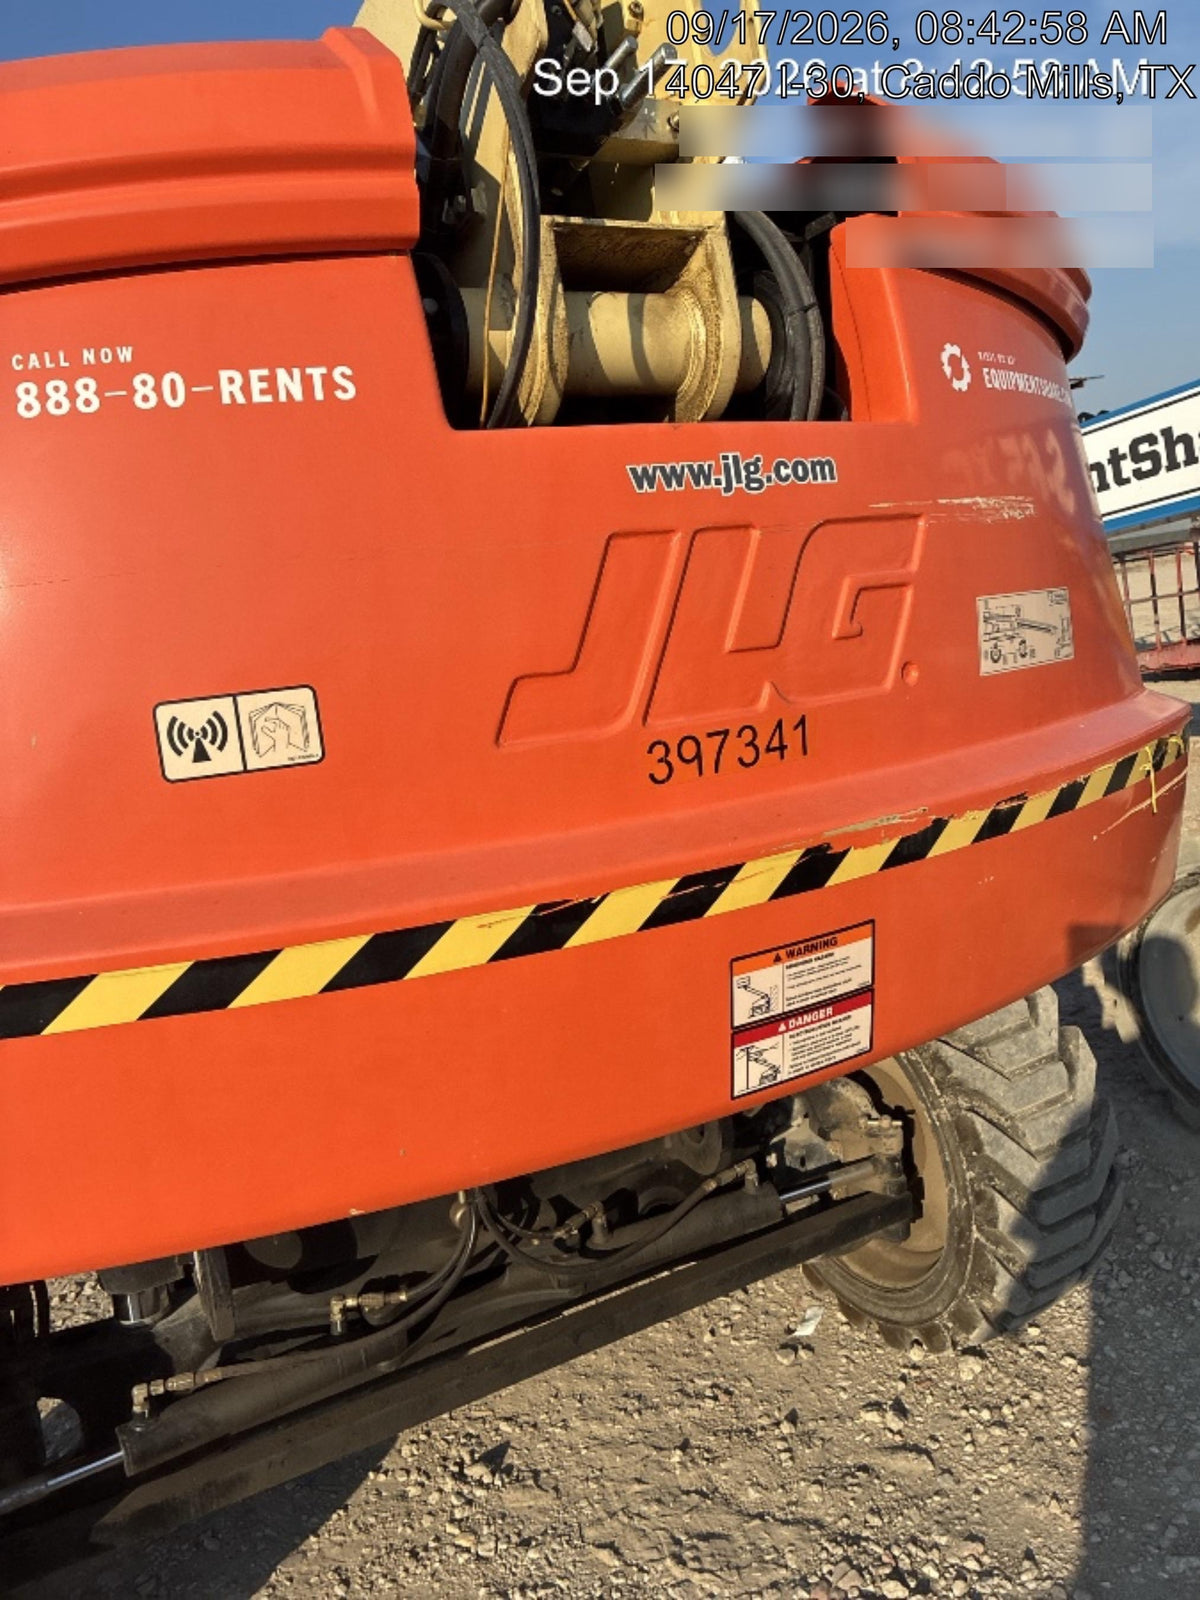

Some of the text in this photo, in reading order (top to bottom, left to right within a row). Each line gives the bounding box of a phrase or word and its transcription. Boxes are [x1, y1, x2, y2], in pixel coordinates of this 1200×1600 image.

[11, 346, 133, 370] CALL NOW
[15, 365, 357, 418] 888-80-RENTS
[625, 452, 837, 496] www.jlg.com
[1090, 426, 1200, 492] ntSh
[495, 513, 924, 749] JLG
[647, 714, 808, 784] 397341
[786, 936, 838, 959] WARNING
[788, 1006, 833, 1029] DANGER
